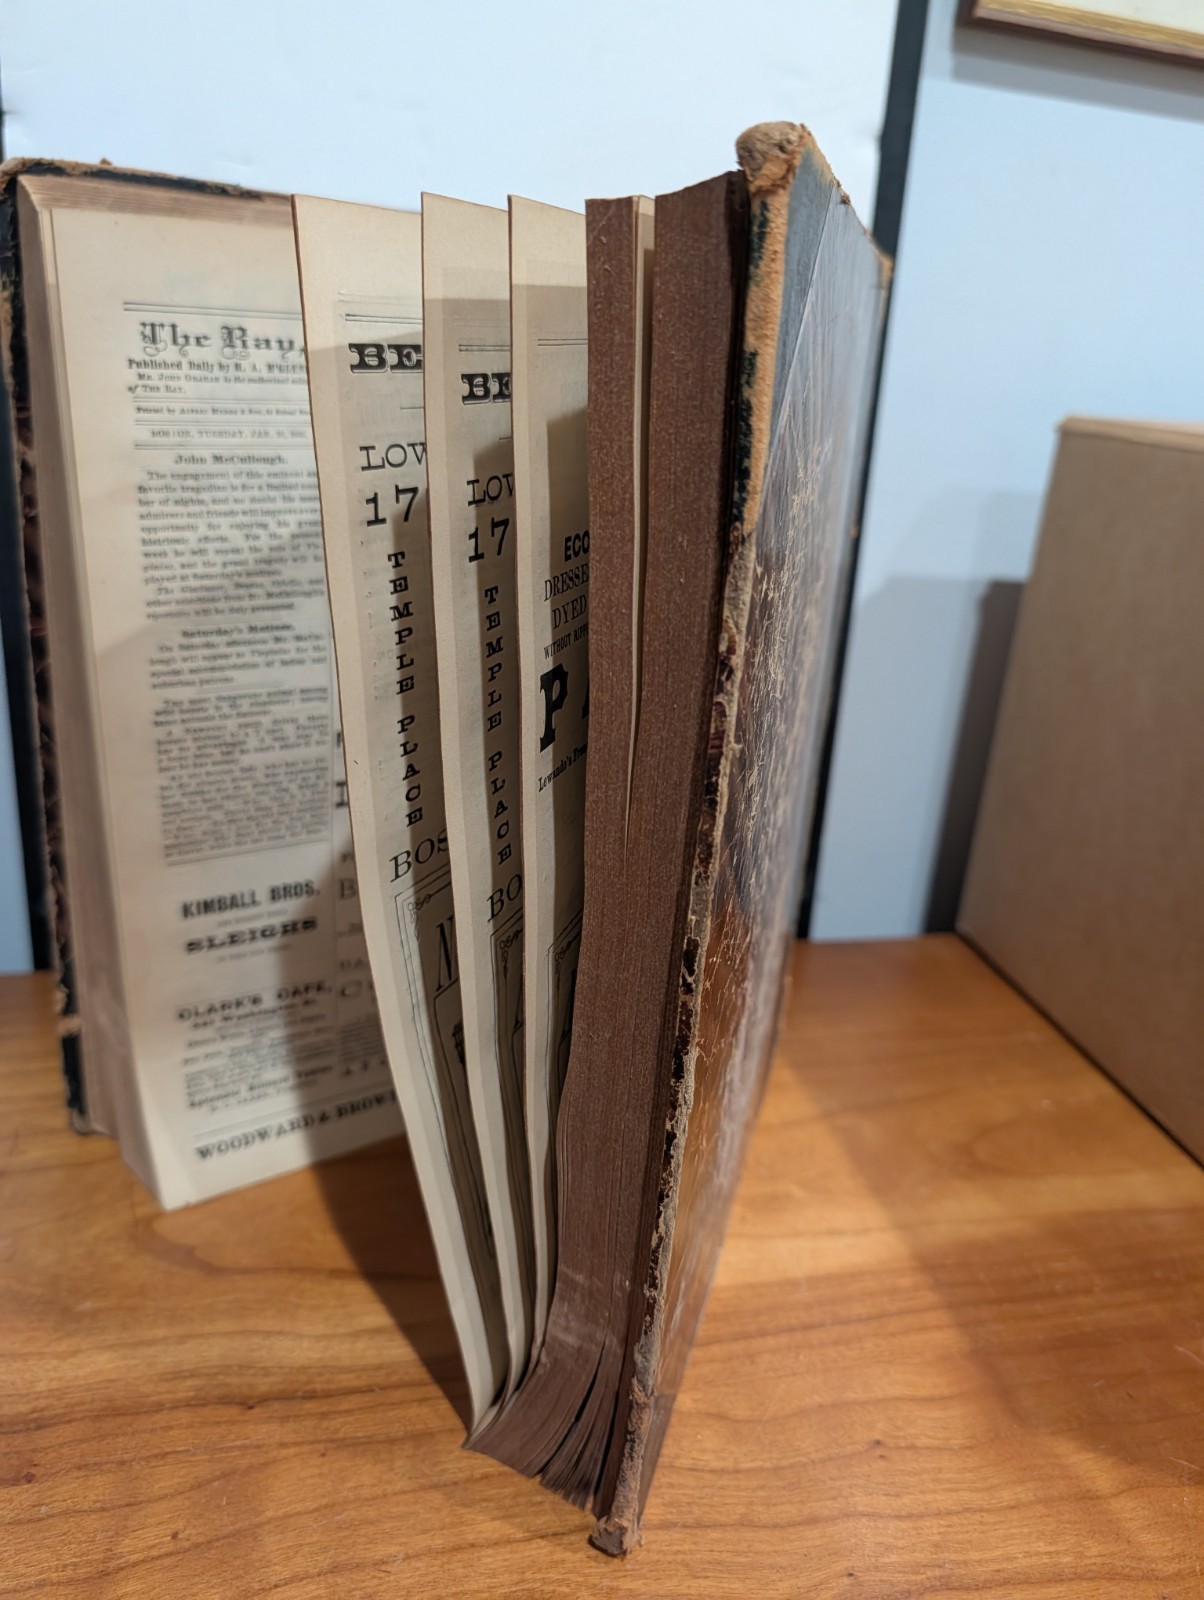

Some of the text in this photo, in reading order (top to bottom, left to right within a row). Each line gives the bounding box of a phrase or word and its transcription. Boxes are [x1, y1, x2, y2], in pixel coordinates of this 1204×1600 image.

[140, 322, 212, 357] The
[128, 358, 182, 370] Published
[188, 360, 214, 373] Daily
[218, 362, 229, 373] by
[175, 455, 288, 465] John McCullough.
[365, 484, 419, 528] 17
[467, 517, 510, 561] 17
[563, 529, 589, 563] ECO
[552, 595, 587, 630] DYED
[544, 632, 572, 660] WITHOUT
[387, 550, 424, 828] TEMPLE PLACE
[484, 585, 513, 866] TEMPLE PLACE
[538, 756, 573, 793] Lewando's
[182, 890, 262, 919] KIMBALL
[186, 916, 318, 954] SLEIGHS
[196, 1113, 316, 1160] WOODWARD
